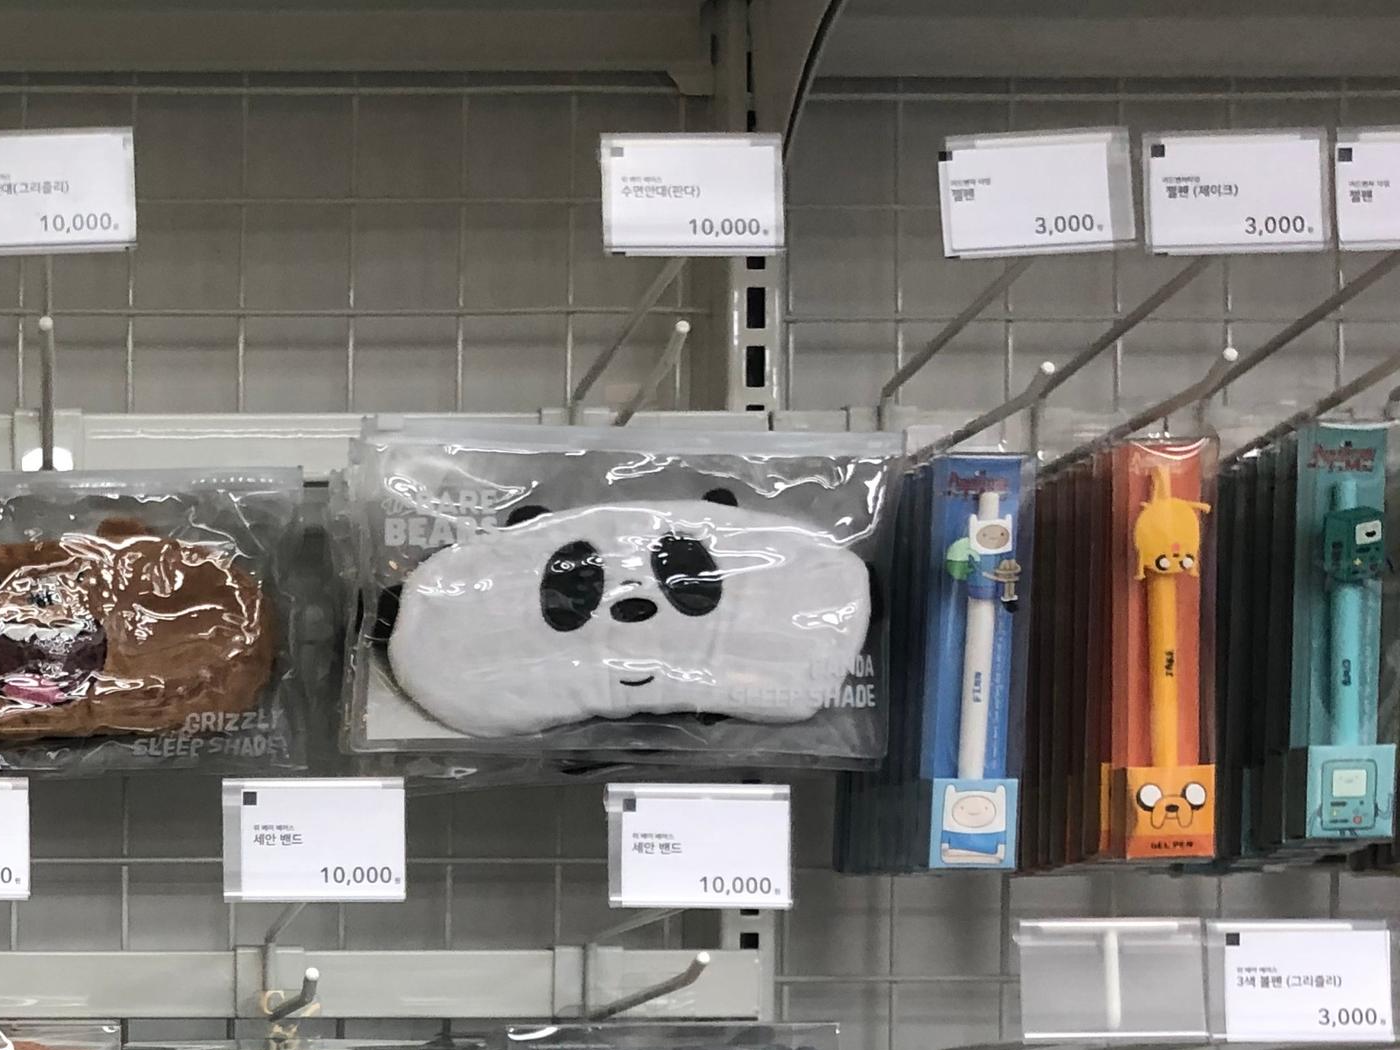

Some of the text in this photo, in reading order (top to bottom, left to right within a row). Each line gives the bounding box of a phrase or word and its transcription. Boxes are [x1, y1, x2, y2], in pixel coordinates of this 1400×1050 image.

[254, 833, 303, 846] 세안 밴드
[632, 841, 655, 854] 세안
